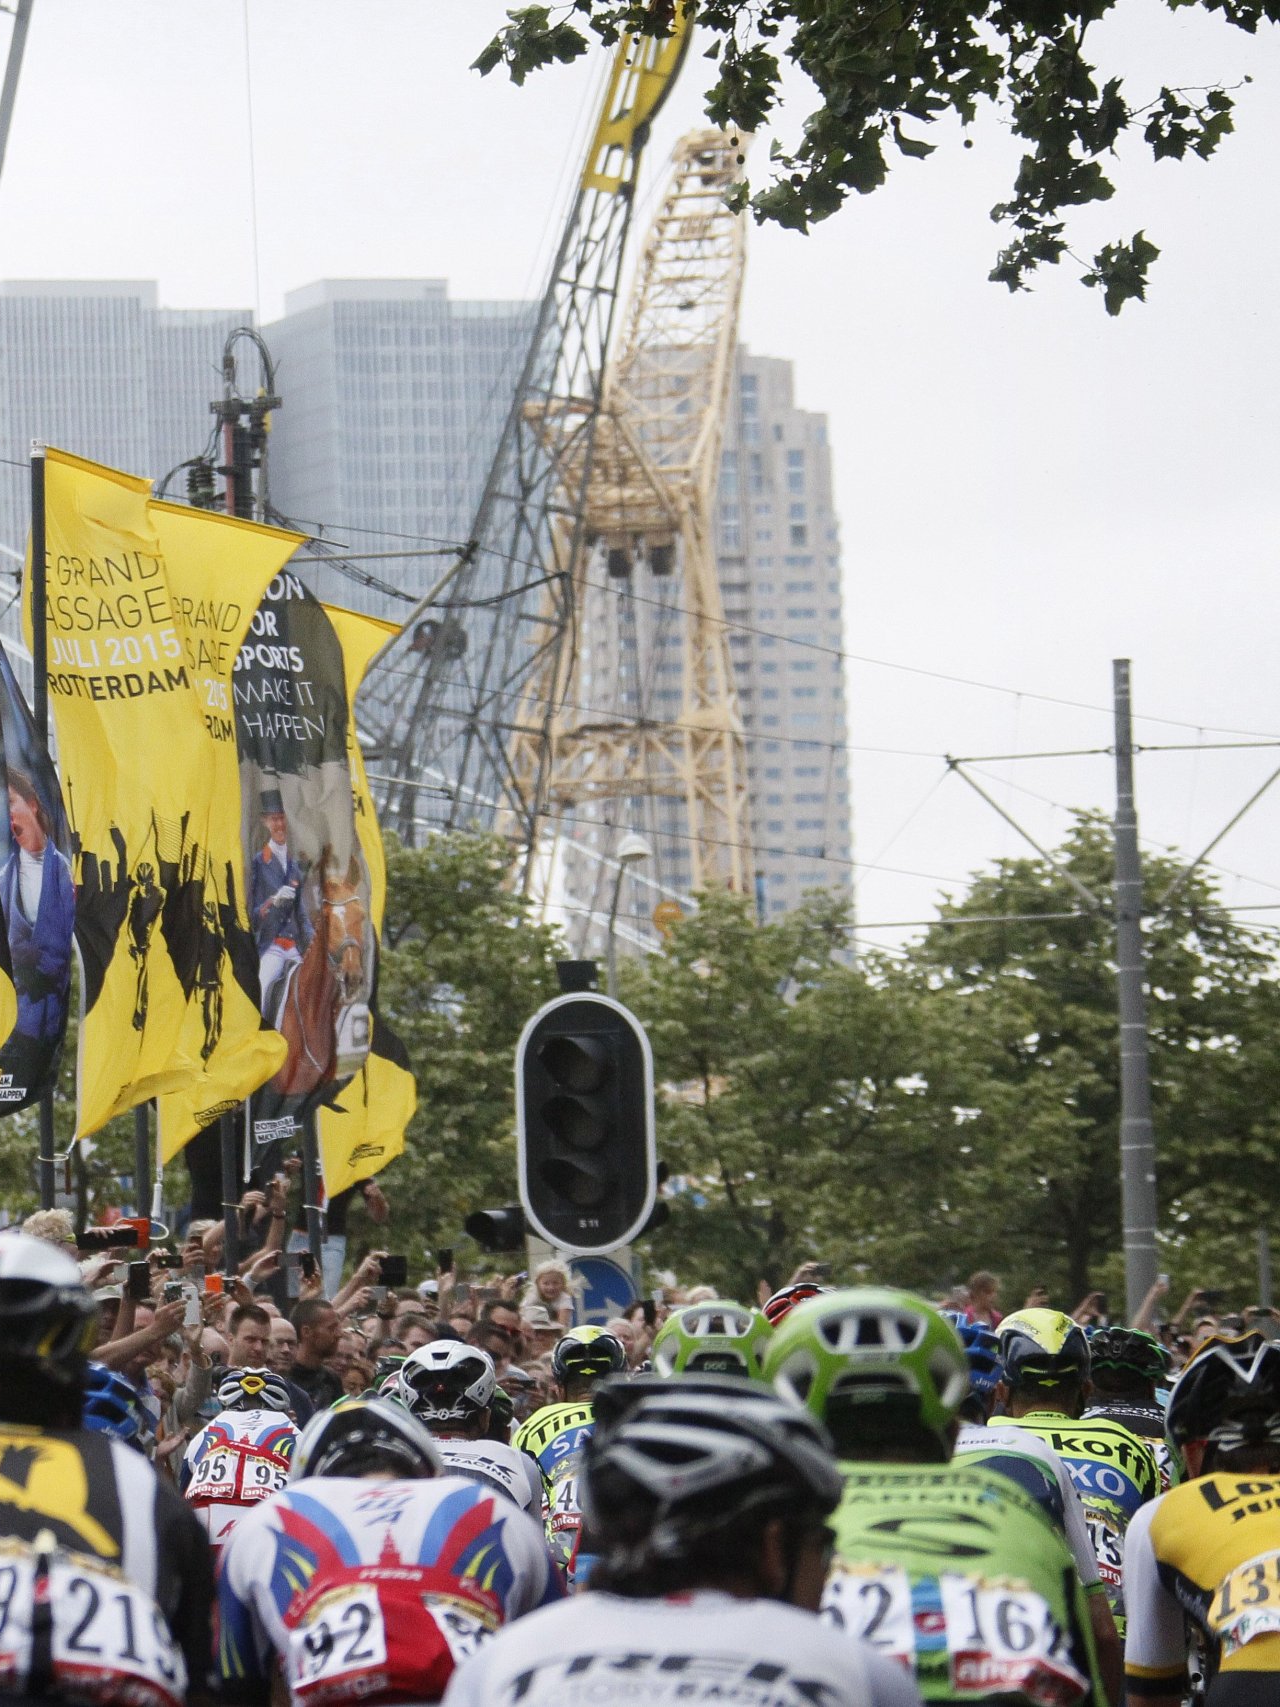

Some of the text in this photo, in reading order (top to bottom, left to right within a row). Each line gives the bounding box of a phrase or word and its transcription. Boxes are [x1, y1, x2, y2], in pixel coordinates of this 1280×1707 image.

[57, 551, 160, 588] GRAND
[52, 628, 181, 669] JULI 2015
[295, 681, 315, 706] IT
[197, 1455, 288, 1490] 95 95
[1065, 1462, 1126, 1497] XO
[557, 1480, 575, 1512] 4
